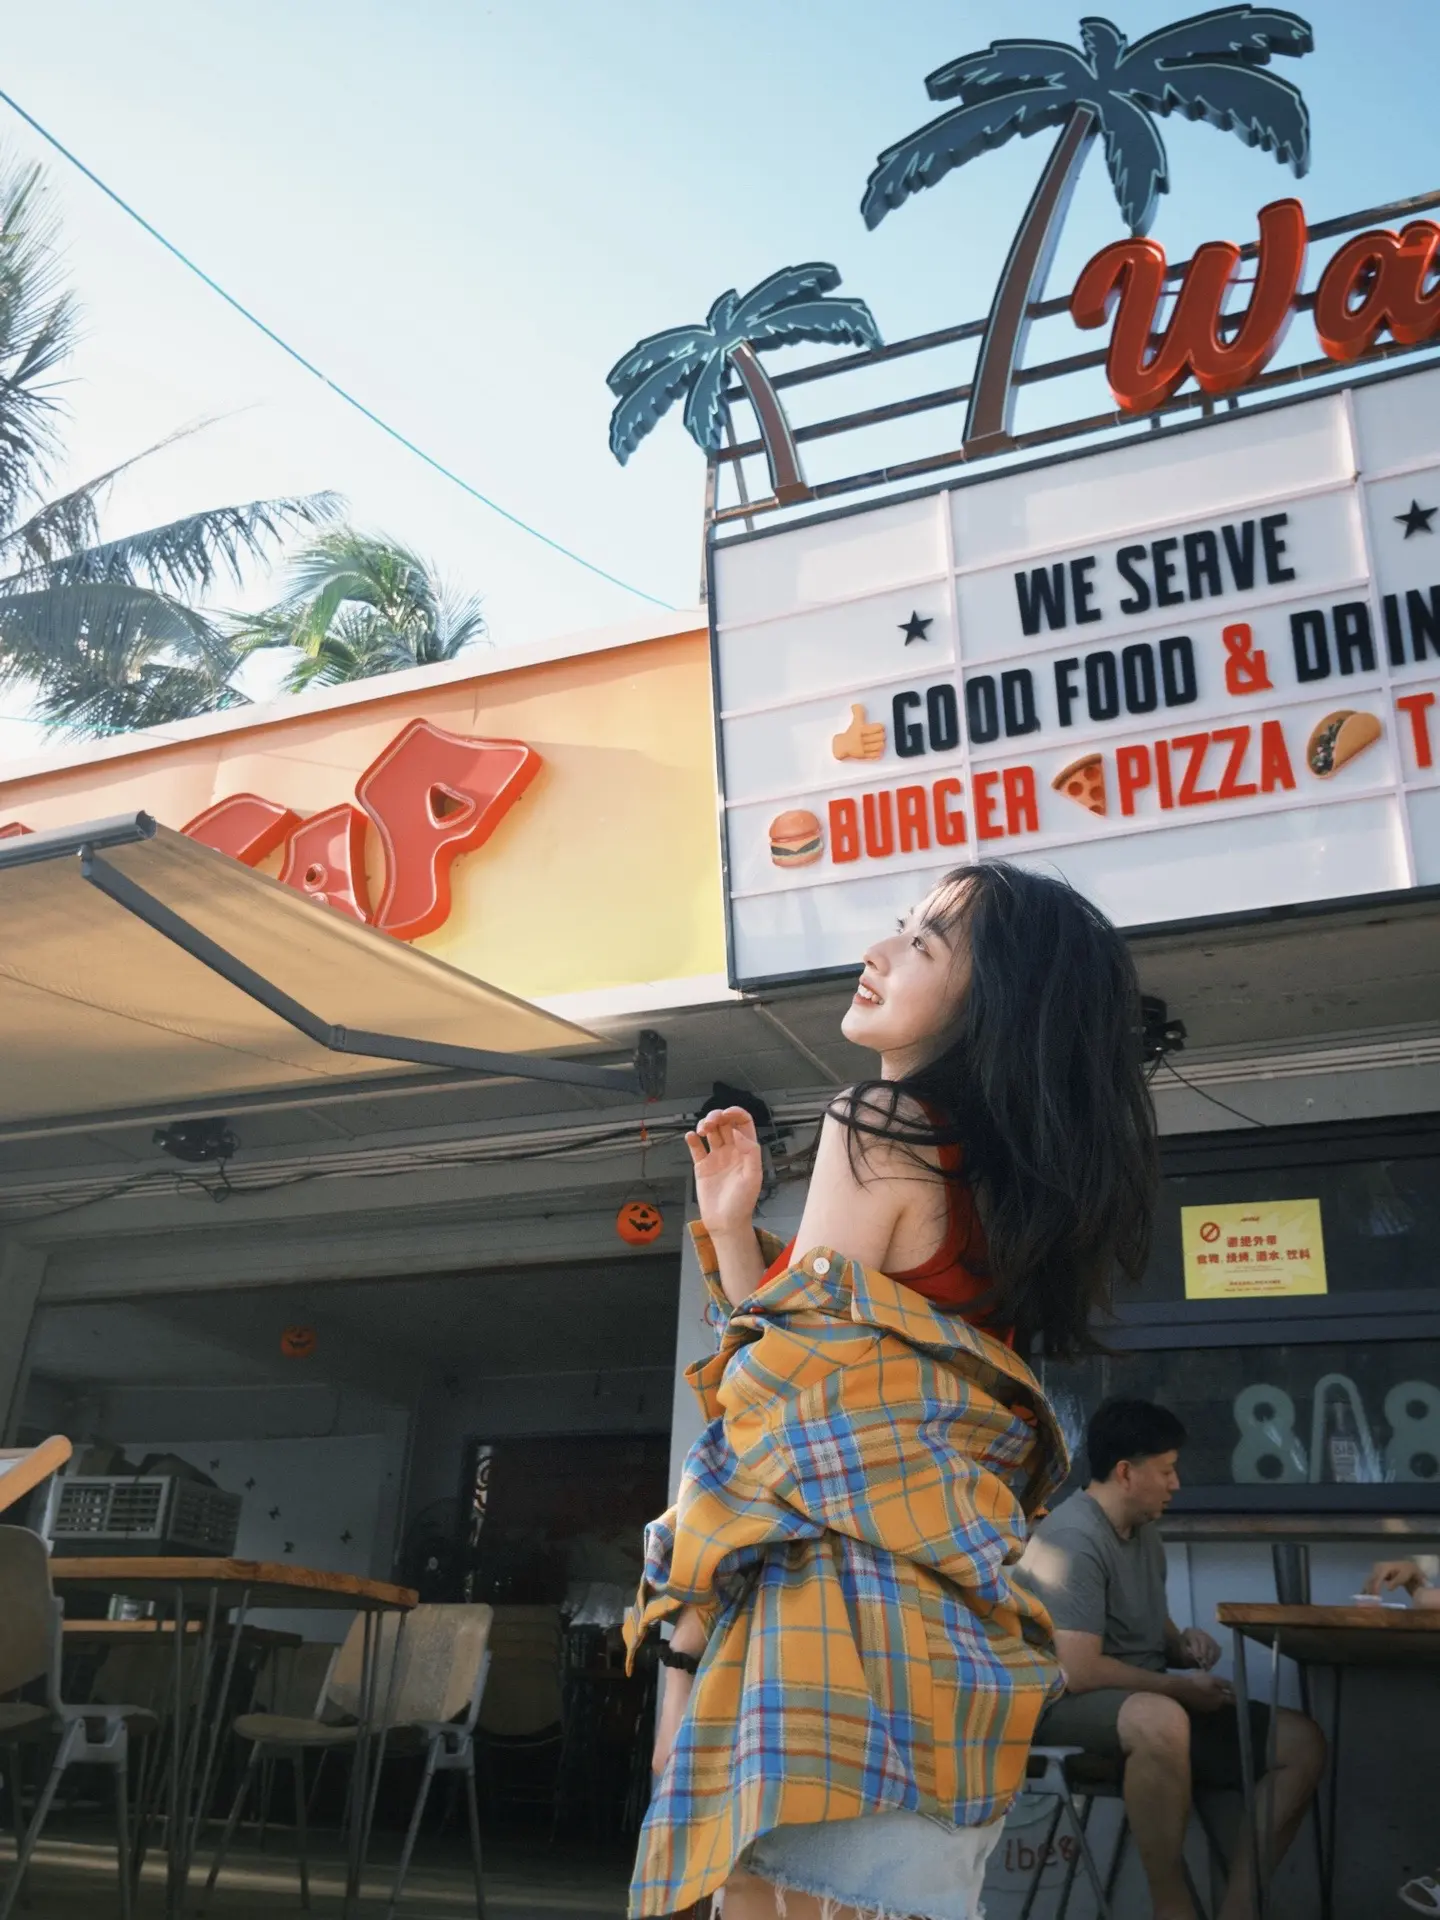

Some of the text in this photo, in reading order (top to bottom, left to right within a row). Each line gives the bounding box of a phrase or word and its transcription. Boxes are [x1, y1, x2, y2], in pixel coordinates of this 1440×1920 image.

[1014, 512, 1296, 636] WE SERVE
[892, 668, 1040, 758] GOOD
[1054, 636, 1198, 727] FOOD
[1222, 622, 1273, 696] &
[828, 764, 1039, 865] BURGER
[1115, 719, 1297, 816] PIZZA
